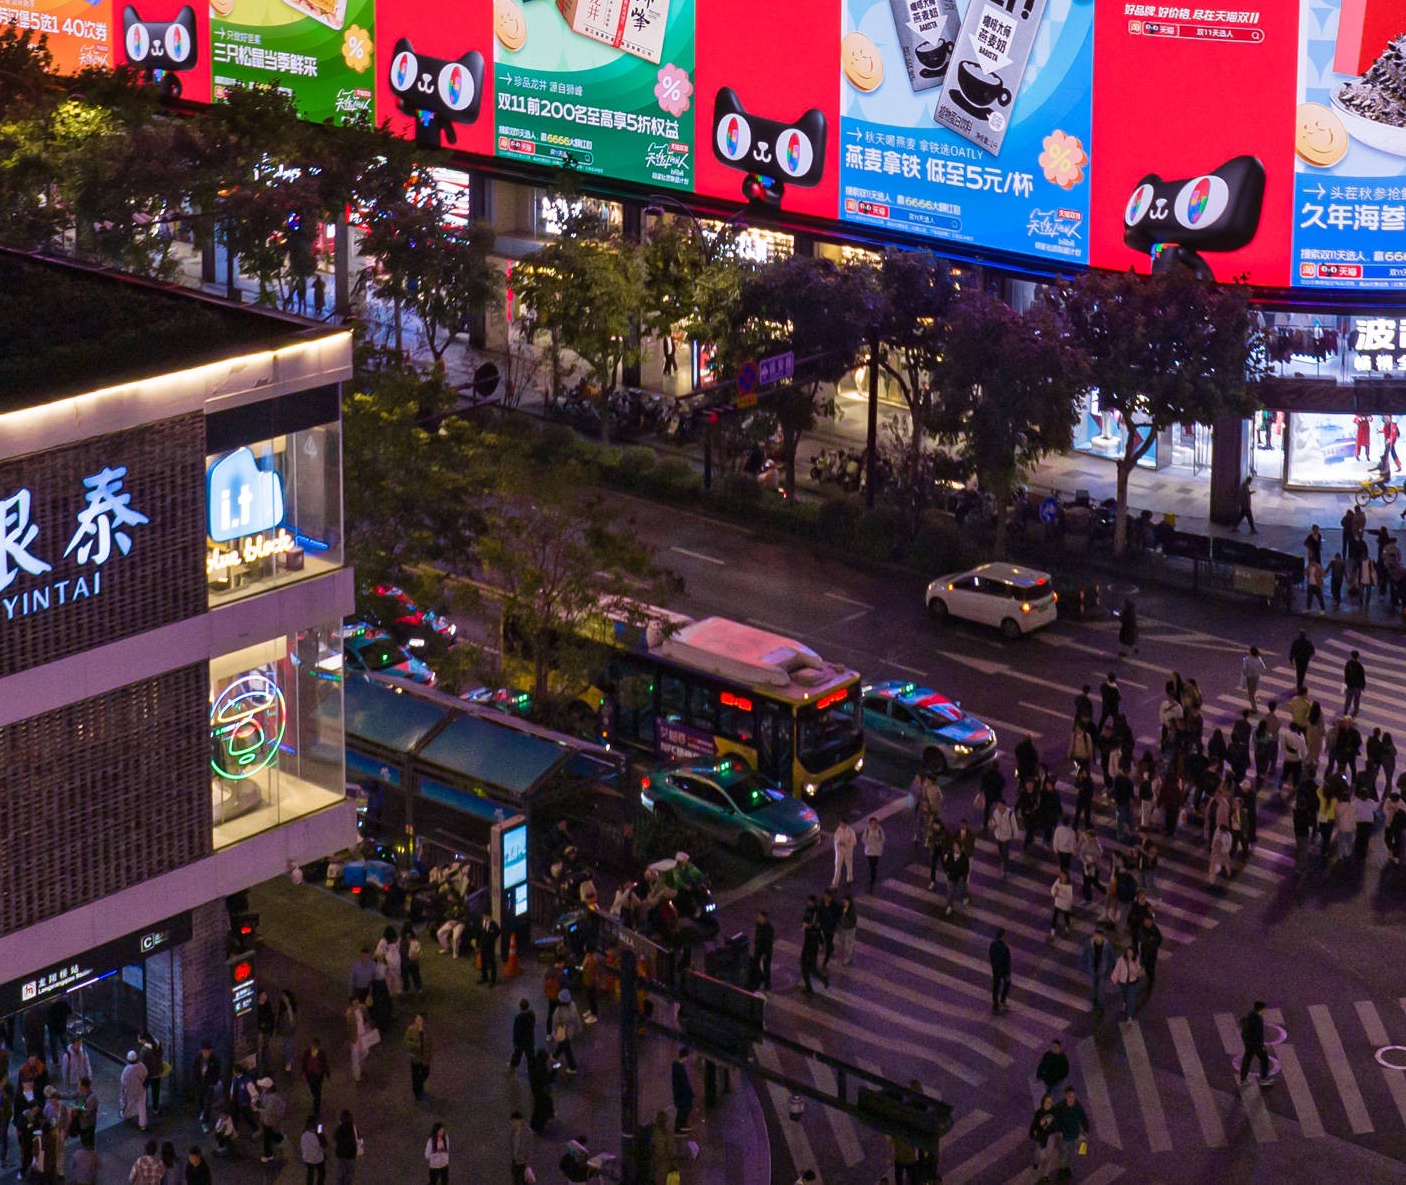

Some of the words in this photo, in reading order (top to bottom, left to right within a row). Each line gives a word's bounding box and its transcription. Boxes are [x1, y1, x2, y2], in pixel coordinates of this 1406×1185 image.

[913, 9, 939, 24] 燕麦奶
[919, 22, 938, 32] BARISTA
[62, 17, 108, 42] 40次券
[977, 28, 1006, 54] 燕麦奶
[214, 42, 318, 77] 三只松鼠当季鲜采
[978, 47, 998, 63] BARISTA
[514, 76, 547, 91] 珍品龙井
[549, 81, 583, 96] 源自狮峰
[498, 92, 680, 139] 双11前200名至高享5折权益
[865, 130, 916, 151] 秋天喝燕麦
[920, 139, 984, 160] 拿铁选OATLY
[845, 144, 921, 180] 燕麦拿铁
[926, 157, 1034, 198] 低至5元/杯
[1, 572, 103, 620] YINTAI
[144, 936, 152, 948] C
